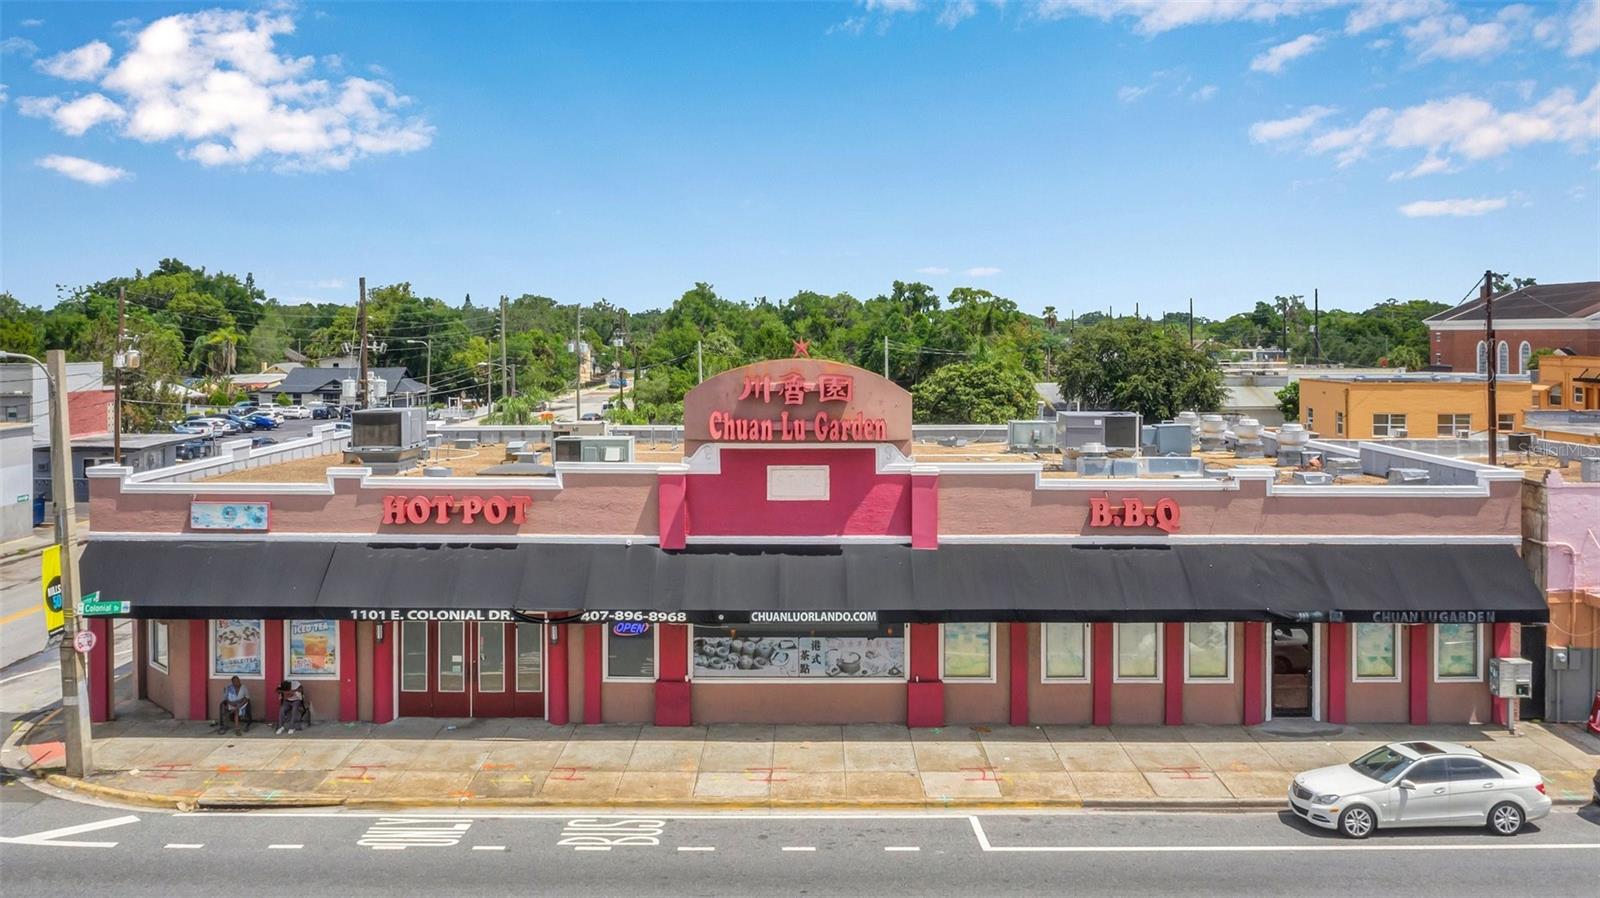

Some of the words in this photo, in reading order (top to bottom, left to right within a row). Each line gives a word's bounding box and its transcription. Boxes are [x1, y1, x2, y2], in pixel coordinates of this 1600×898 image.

[738, 371, 854, 405] 川香園
[709, 410, 773, 441] Chuan
[781, 410, 806, 440] Lu
[814, 410, 888, 441] Garden
[382, 495, 455, 525] HOT
[461, 495, 532, 525] POT
[1089, 497, 1181, 533] B.B.Q
[85, 603, 112, 613] Colonial
[350, 610, 386, 620] 1101
[391, 610, 404, 620] E.
[407, 610, 485, 620] COLONIAL
[488, 610, 514, 620] DR.
[580, 611, 687, 622] 407-896-8968
[751, 611, 877, 622] CHUANLUORLANDO.COM
[1372, 611, 1418, 622] CHUAN
[1421, 611, 1437, 622] LU
[1440, 611, 1496, 622] GARDEN
[313, 622, 329, 632] TEA
[616, 622, 645, 633] OPEN
[356, 817, 474, 846] ONLY
[556, 818, 666, 846] BUS
